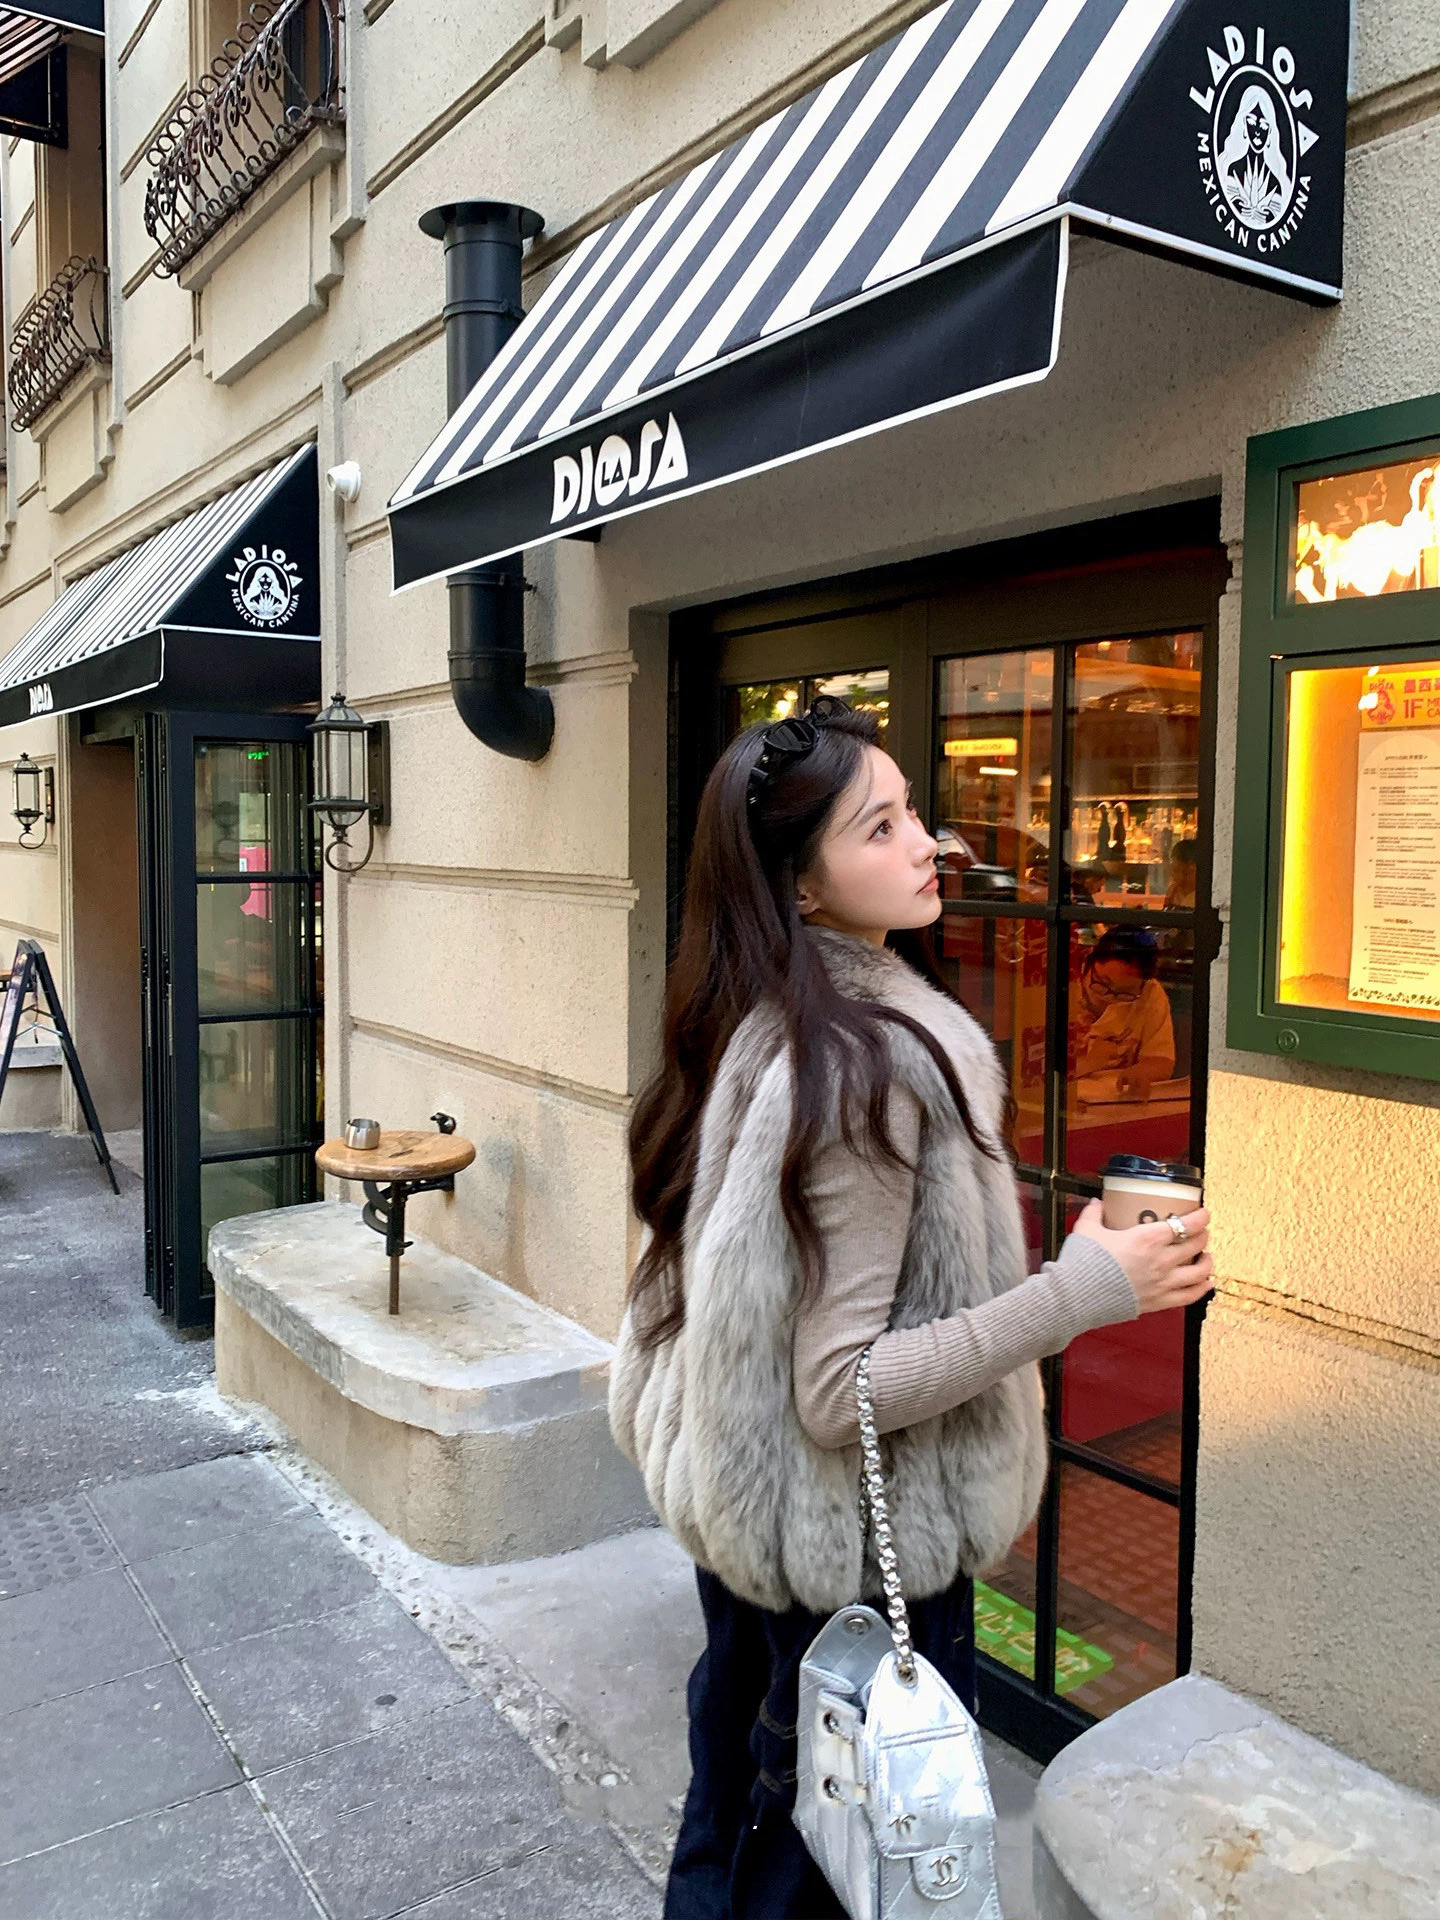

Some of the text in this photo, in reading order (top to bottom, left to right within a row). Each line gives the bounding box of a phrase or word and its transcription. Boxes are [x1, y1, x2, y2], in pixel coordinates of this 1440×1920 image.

[1197, 132, 1312, 253] MEXICAN CANTINA
[231, 589, 300, 628] MEXICAN CANTINA
[1403, 698, 1424, 719] 1F
